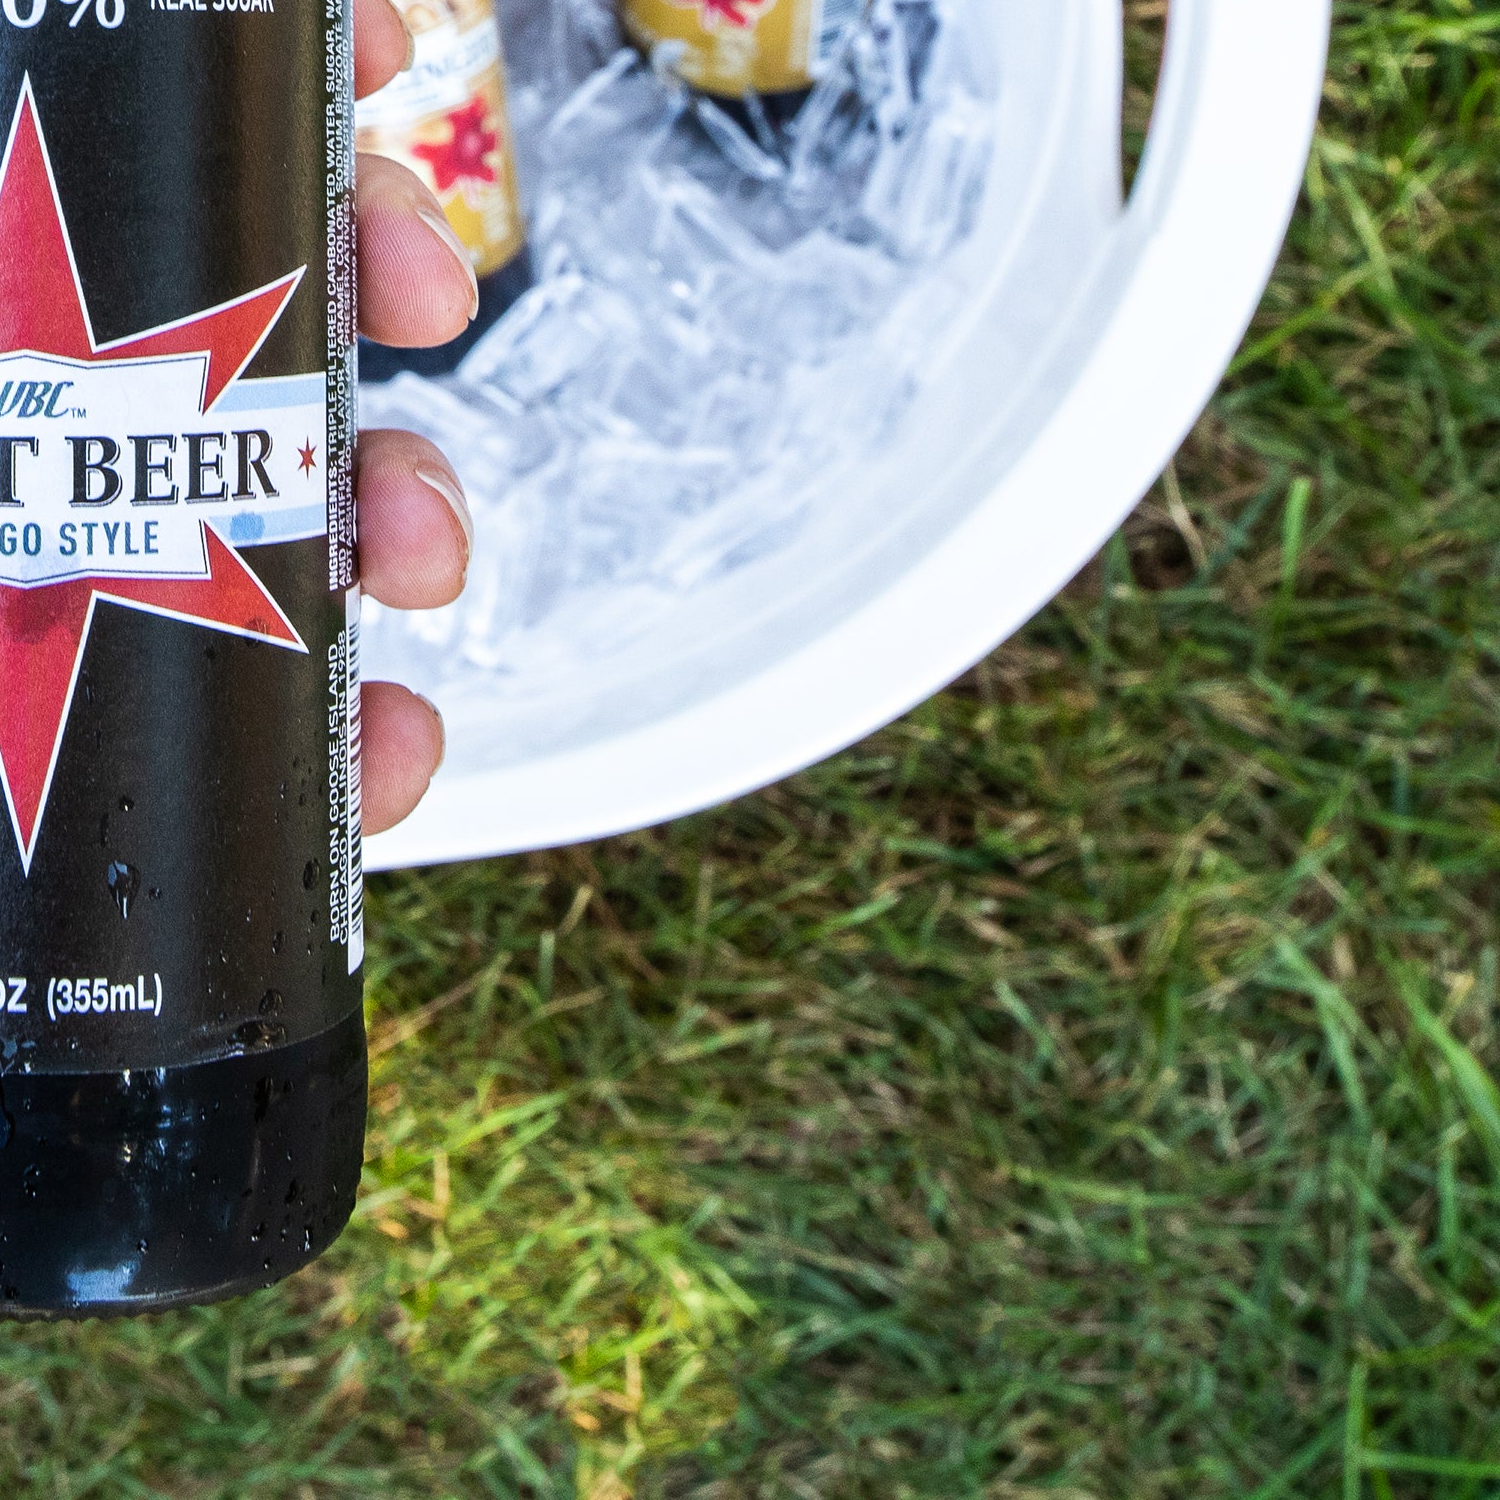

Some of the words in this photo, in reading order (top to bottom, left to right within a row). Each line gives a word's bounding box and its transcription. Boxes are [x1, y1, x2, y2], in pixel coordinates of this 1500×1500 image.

[334, 21, 343, 115] BENZOATE
[335, 118, 344, 194] SODIUM
[326, 173, 336, 296] CARBONATED
[343, 193, 351, 347] PRESERVATIVES)
[327, 300, 337, 387] FILTERED
[336, 270, 344, 358] CARAMEL
[327, 388, 337, 456] TRIPLE
[65, 430, 278, 508] BEER
[337, 443, 346, 543] ARTIFICIAL
[59, 521, 160, 557] STYLE
[328, 460, 338, 591] INGREDIENTS:
[337, 548, 346, 587] AND
[345, 475, 353, 584] POTASSIUM
[327, 643, 338, 734] ISLAND
[338, 690, 346, 716] IN
[328, 739, 339, 823] GOOSE
[338, 722, 347, 826] ILLINOIS
[329, 826, 340, 865] ON
[329, 869, 340, 943] BORN
[46, 972, 164, 1018] (355mL)
